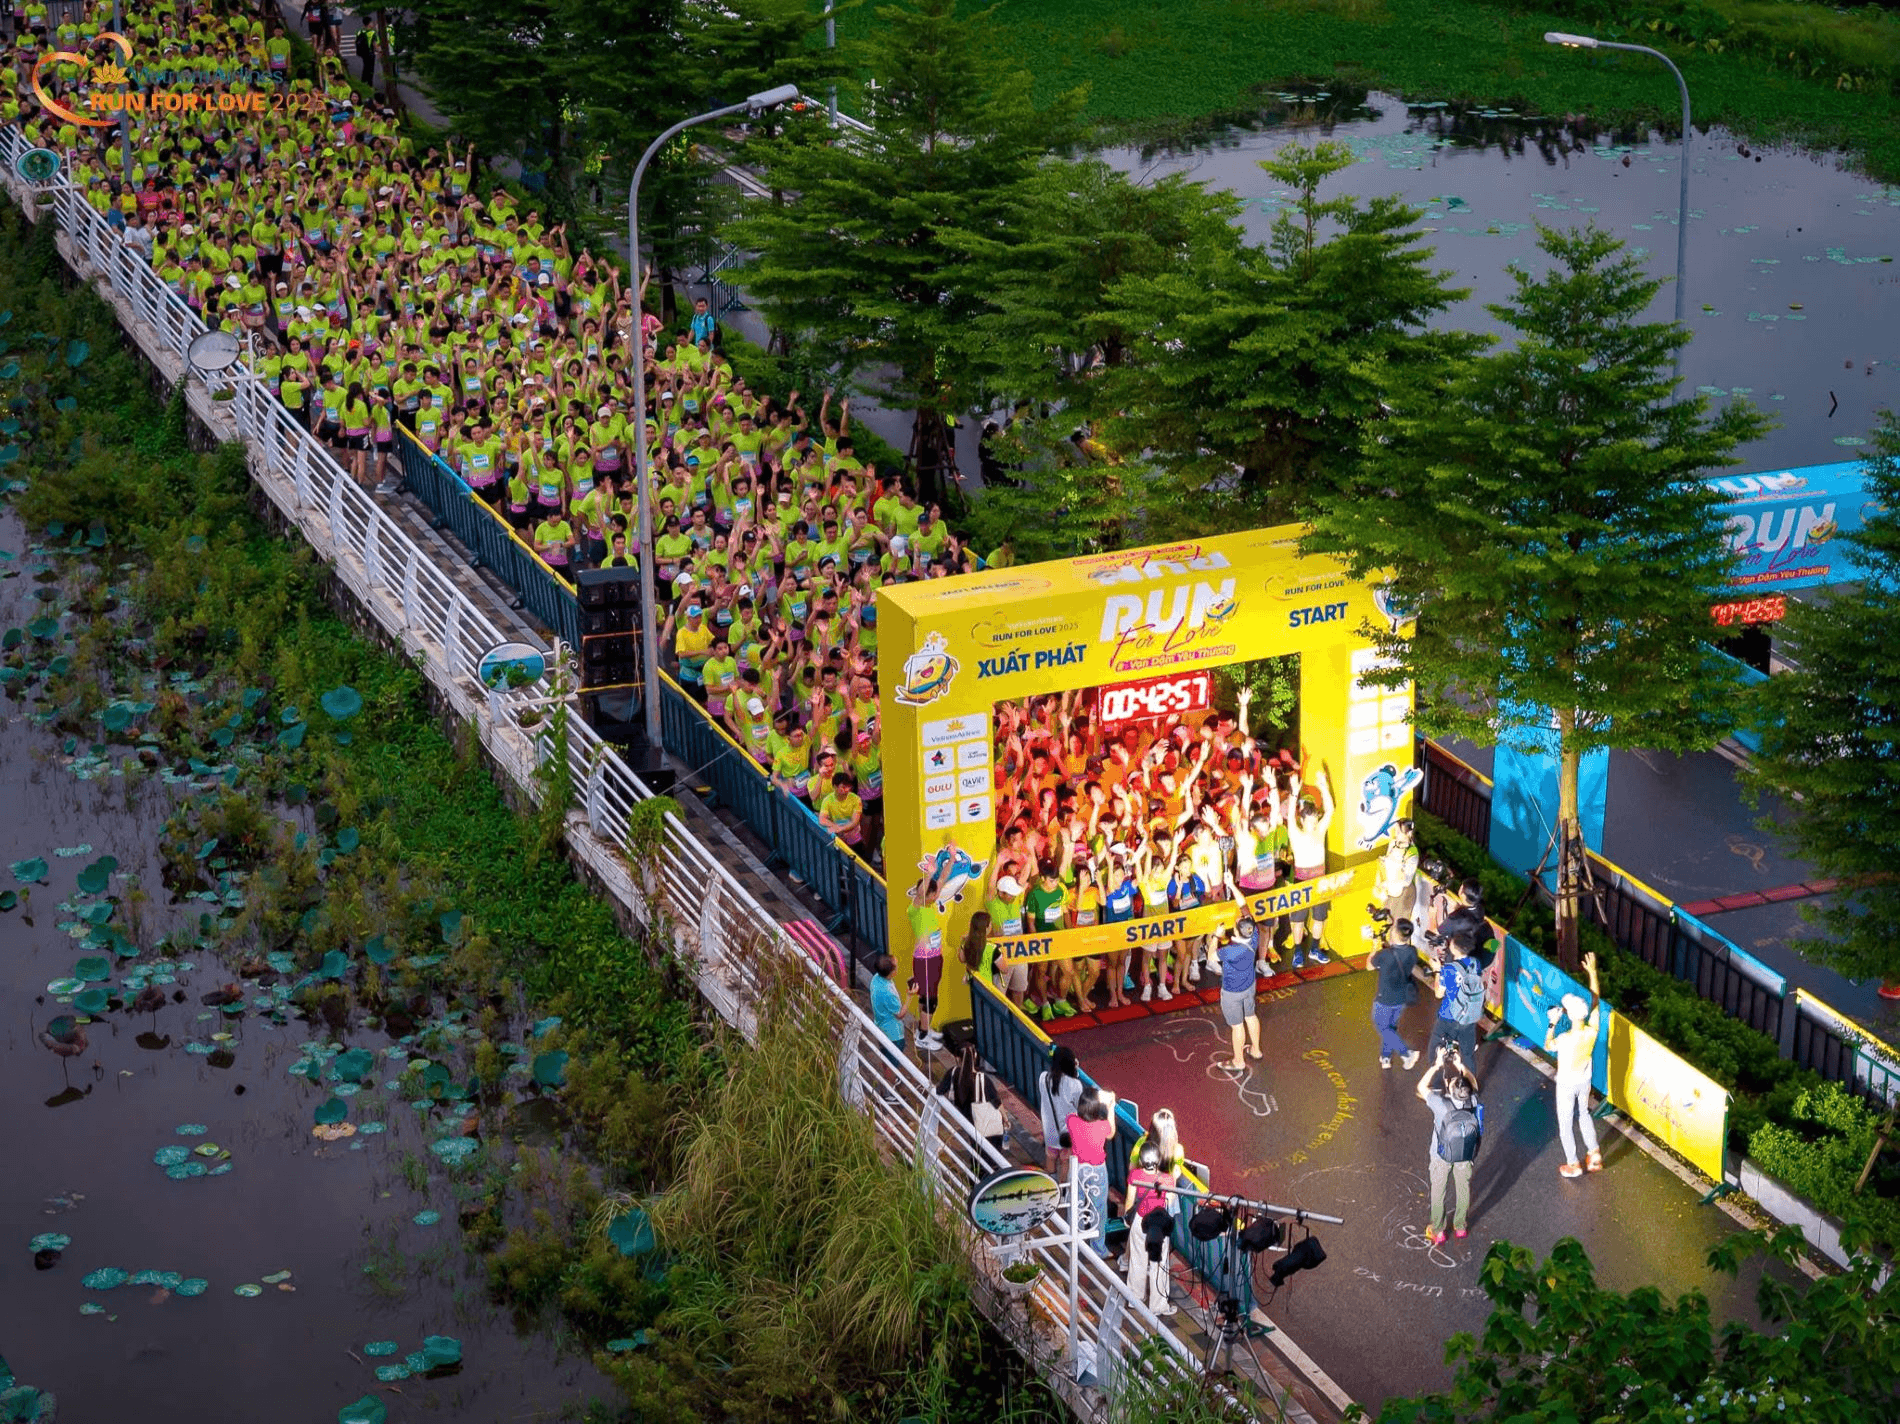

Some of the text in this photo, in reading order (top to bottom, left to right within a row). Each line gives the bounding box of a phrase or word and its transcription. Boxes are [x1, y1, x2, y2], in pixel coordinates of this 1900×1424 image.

[1284, 580, 1345, 595] RUN FOR LOVE
[1100, 577, 1237, 642] RUN
[1288, 601, 1349, 628] START
[992, 631, 1014, 643] RUN
[1014, 628, 1033, 640] FOR
[1034, 624, 1057, 636] LOVE
[1109, 616, 1222, 668] For Love
[977, 641, 1087, 679] XUẤT PHÁT
[1101, 676, 1209, 722] 00:42:57
[1125, 917, 1188, 943] START
[1254, 886, 1313, 917] START
